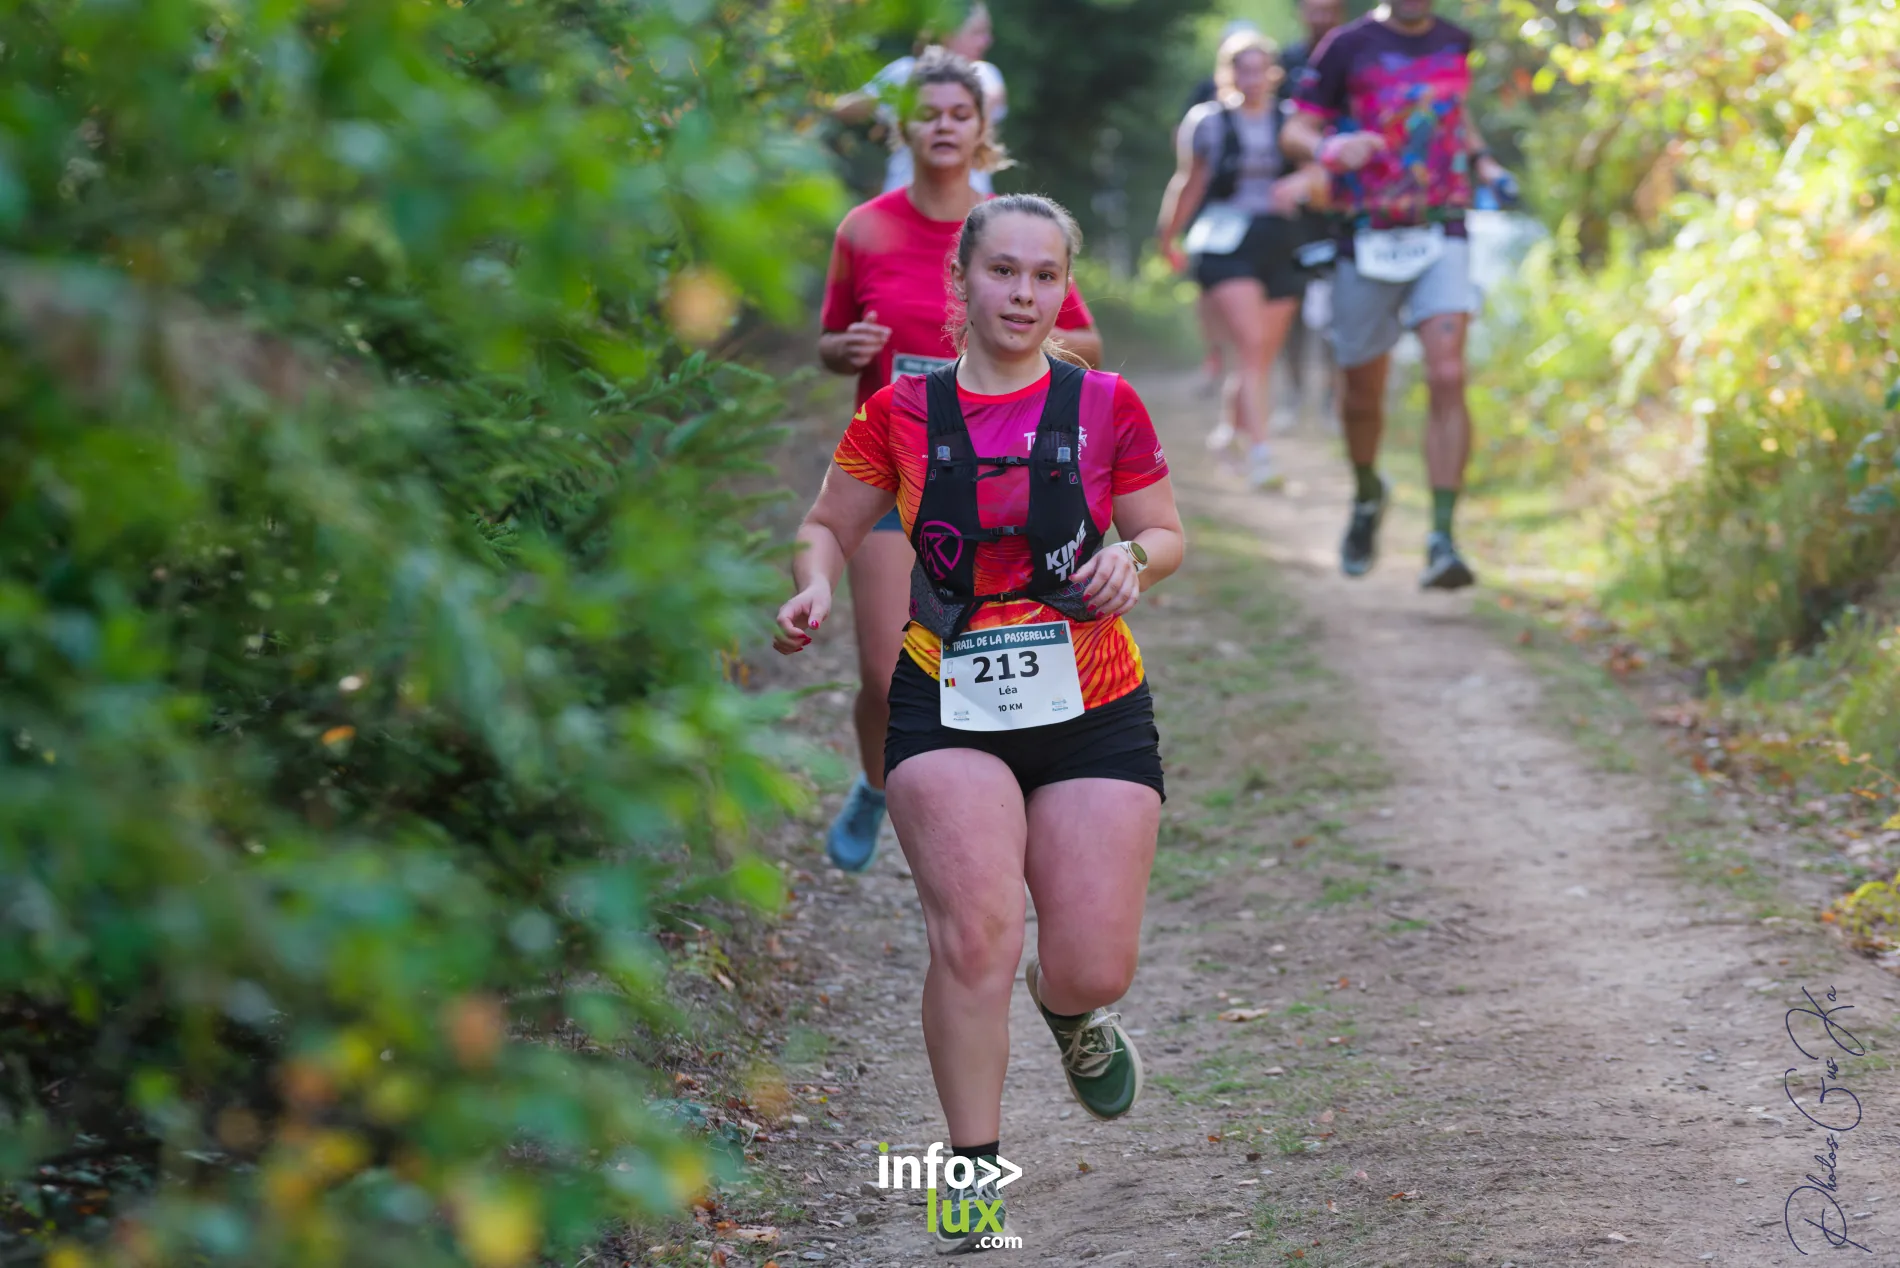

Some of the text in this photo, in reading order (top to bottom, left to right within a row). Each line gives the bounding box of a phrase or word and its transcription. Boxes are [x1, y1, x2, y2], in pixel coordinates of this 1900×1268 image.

[952, 628, 1056, 652] TRAIL DE LA PASSERELLE
[972, 650, 1040, 684] 213
[999, 685, 1018, 696] Léa
[998, 702, 1023, 713] 10 KM
